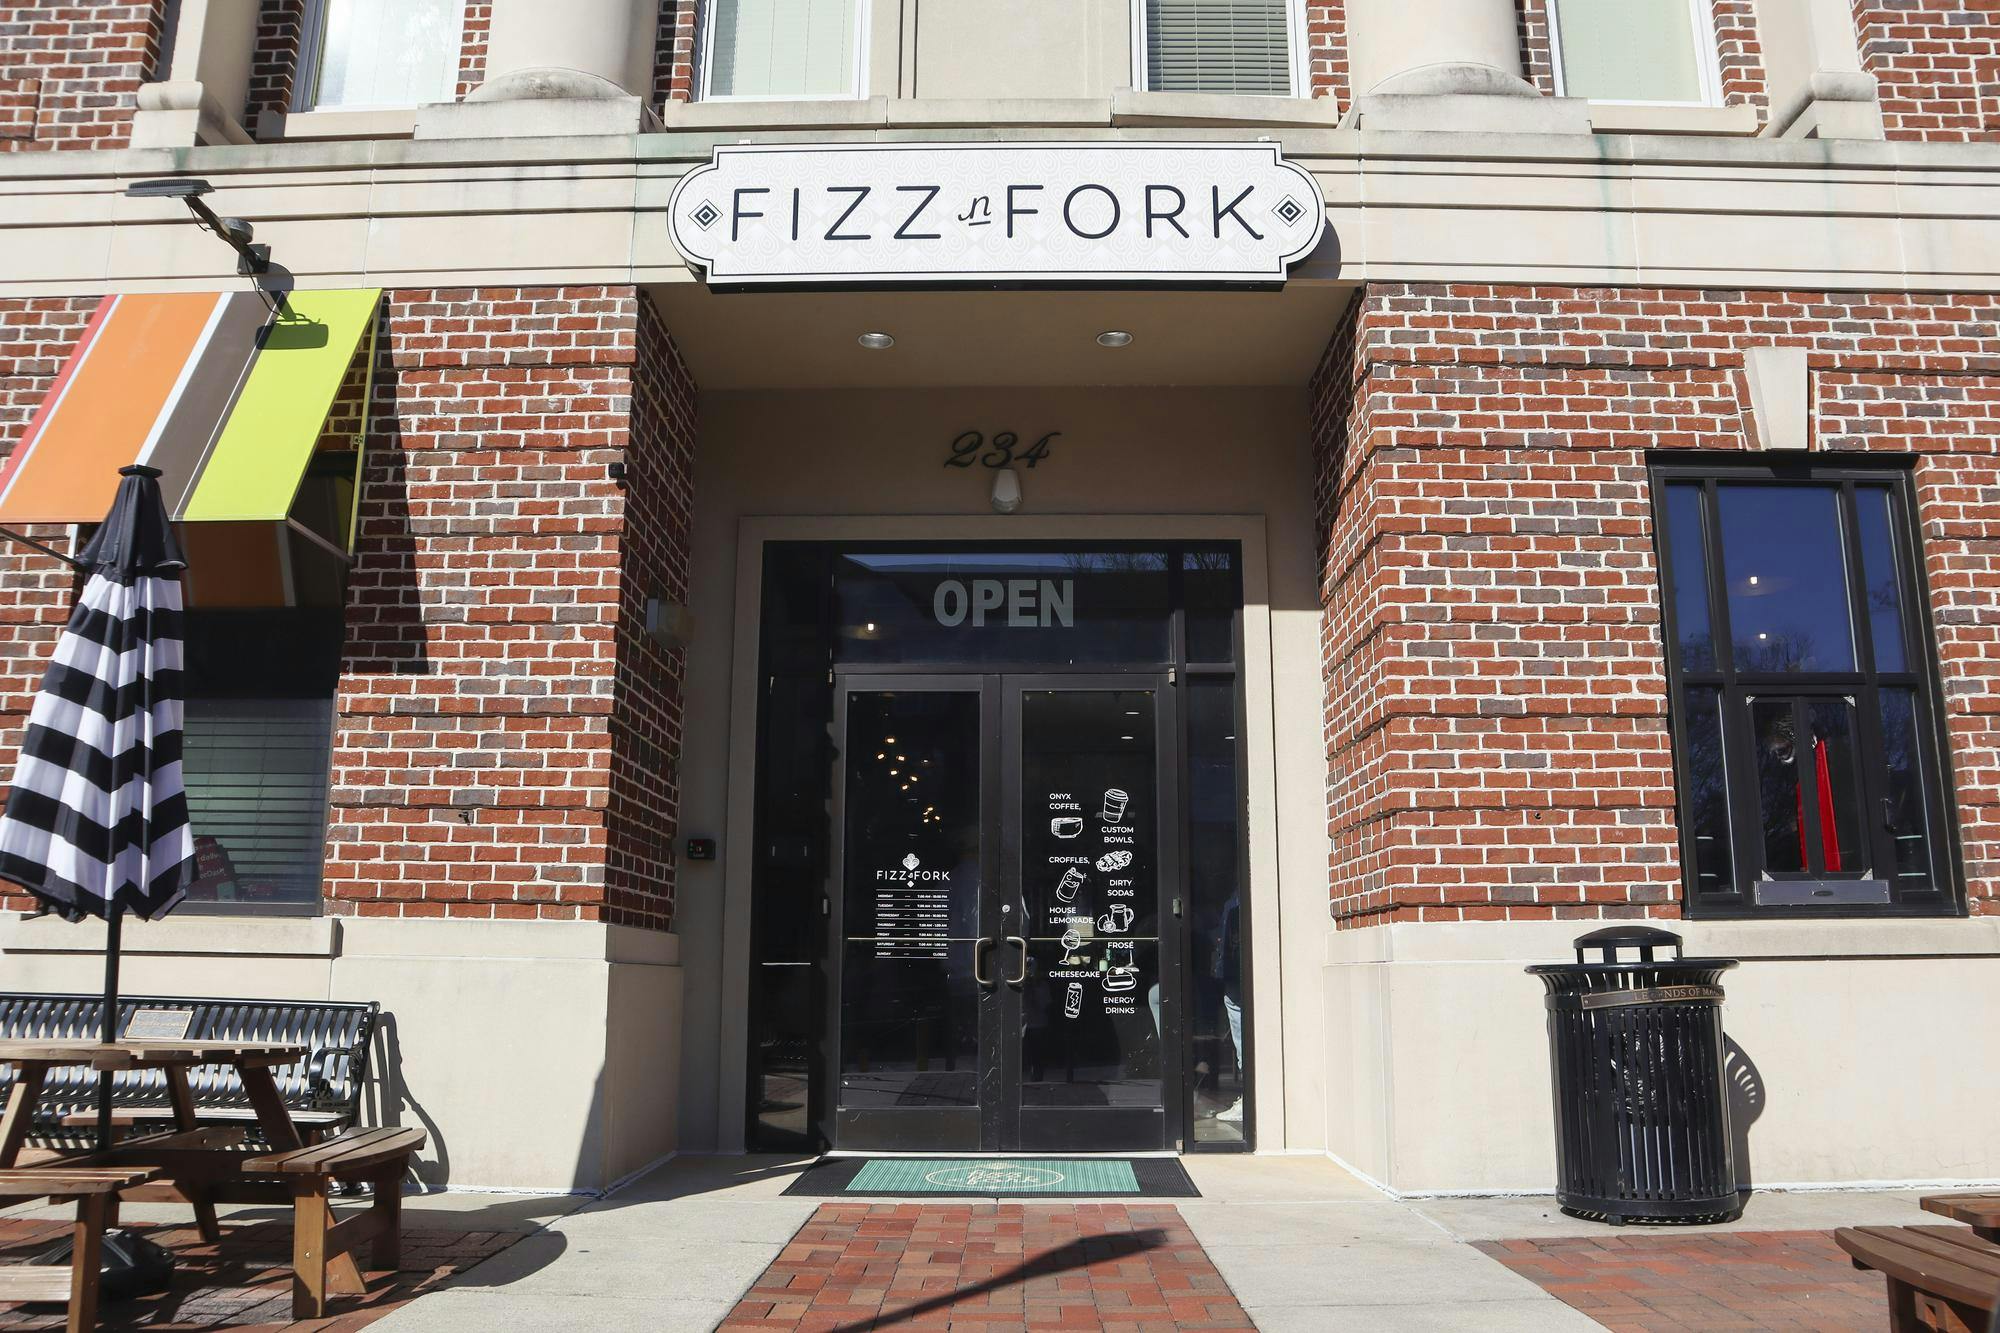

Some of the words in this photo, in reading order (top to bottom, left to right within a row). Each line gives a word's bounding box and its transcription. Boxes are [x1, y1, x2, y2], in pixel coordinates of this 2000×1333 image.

[731, 185, 942, 242] FIZZ
[957, 195, 992, 227] n
[1006, 183, 1265, 241] FORK
[943, 430, 1063, 469] 234
[933, 579, 1074, 628] OPEN
[1049, 803, 1082, 811] COFFEE,
[1101, 826, 1134, 834] CUSTOM
[1103, 836, 1135, 844] BOWLS,
[1048, 856, 1091, 865] CROFFLES,
[876, 870, 907, 881] FIZZ
[913, 870, 951, 881] FORK
[1109, 879, 1133, 887] DIRTY
[1107, 889, 1135, 897] SODAS
[1049, 906, 1077, 914] HOUSE
[1049, 917, 1096, 925] LEMONADE,
[1048, 970, 1101, 978] CHEESECAKE
[1103, 996, 1136, 1004] ENERGY
[1105, 1006, 1135, 1014] DRINKS
